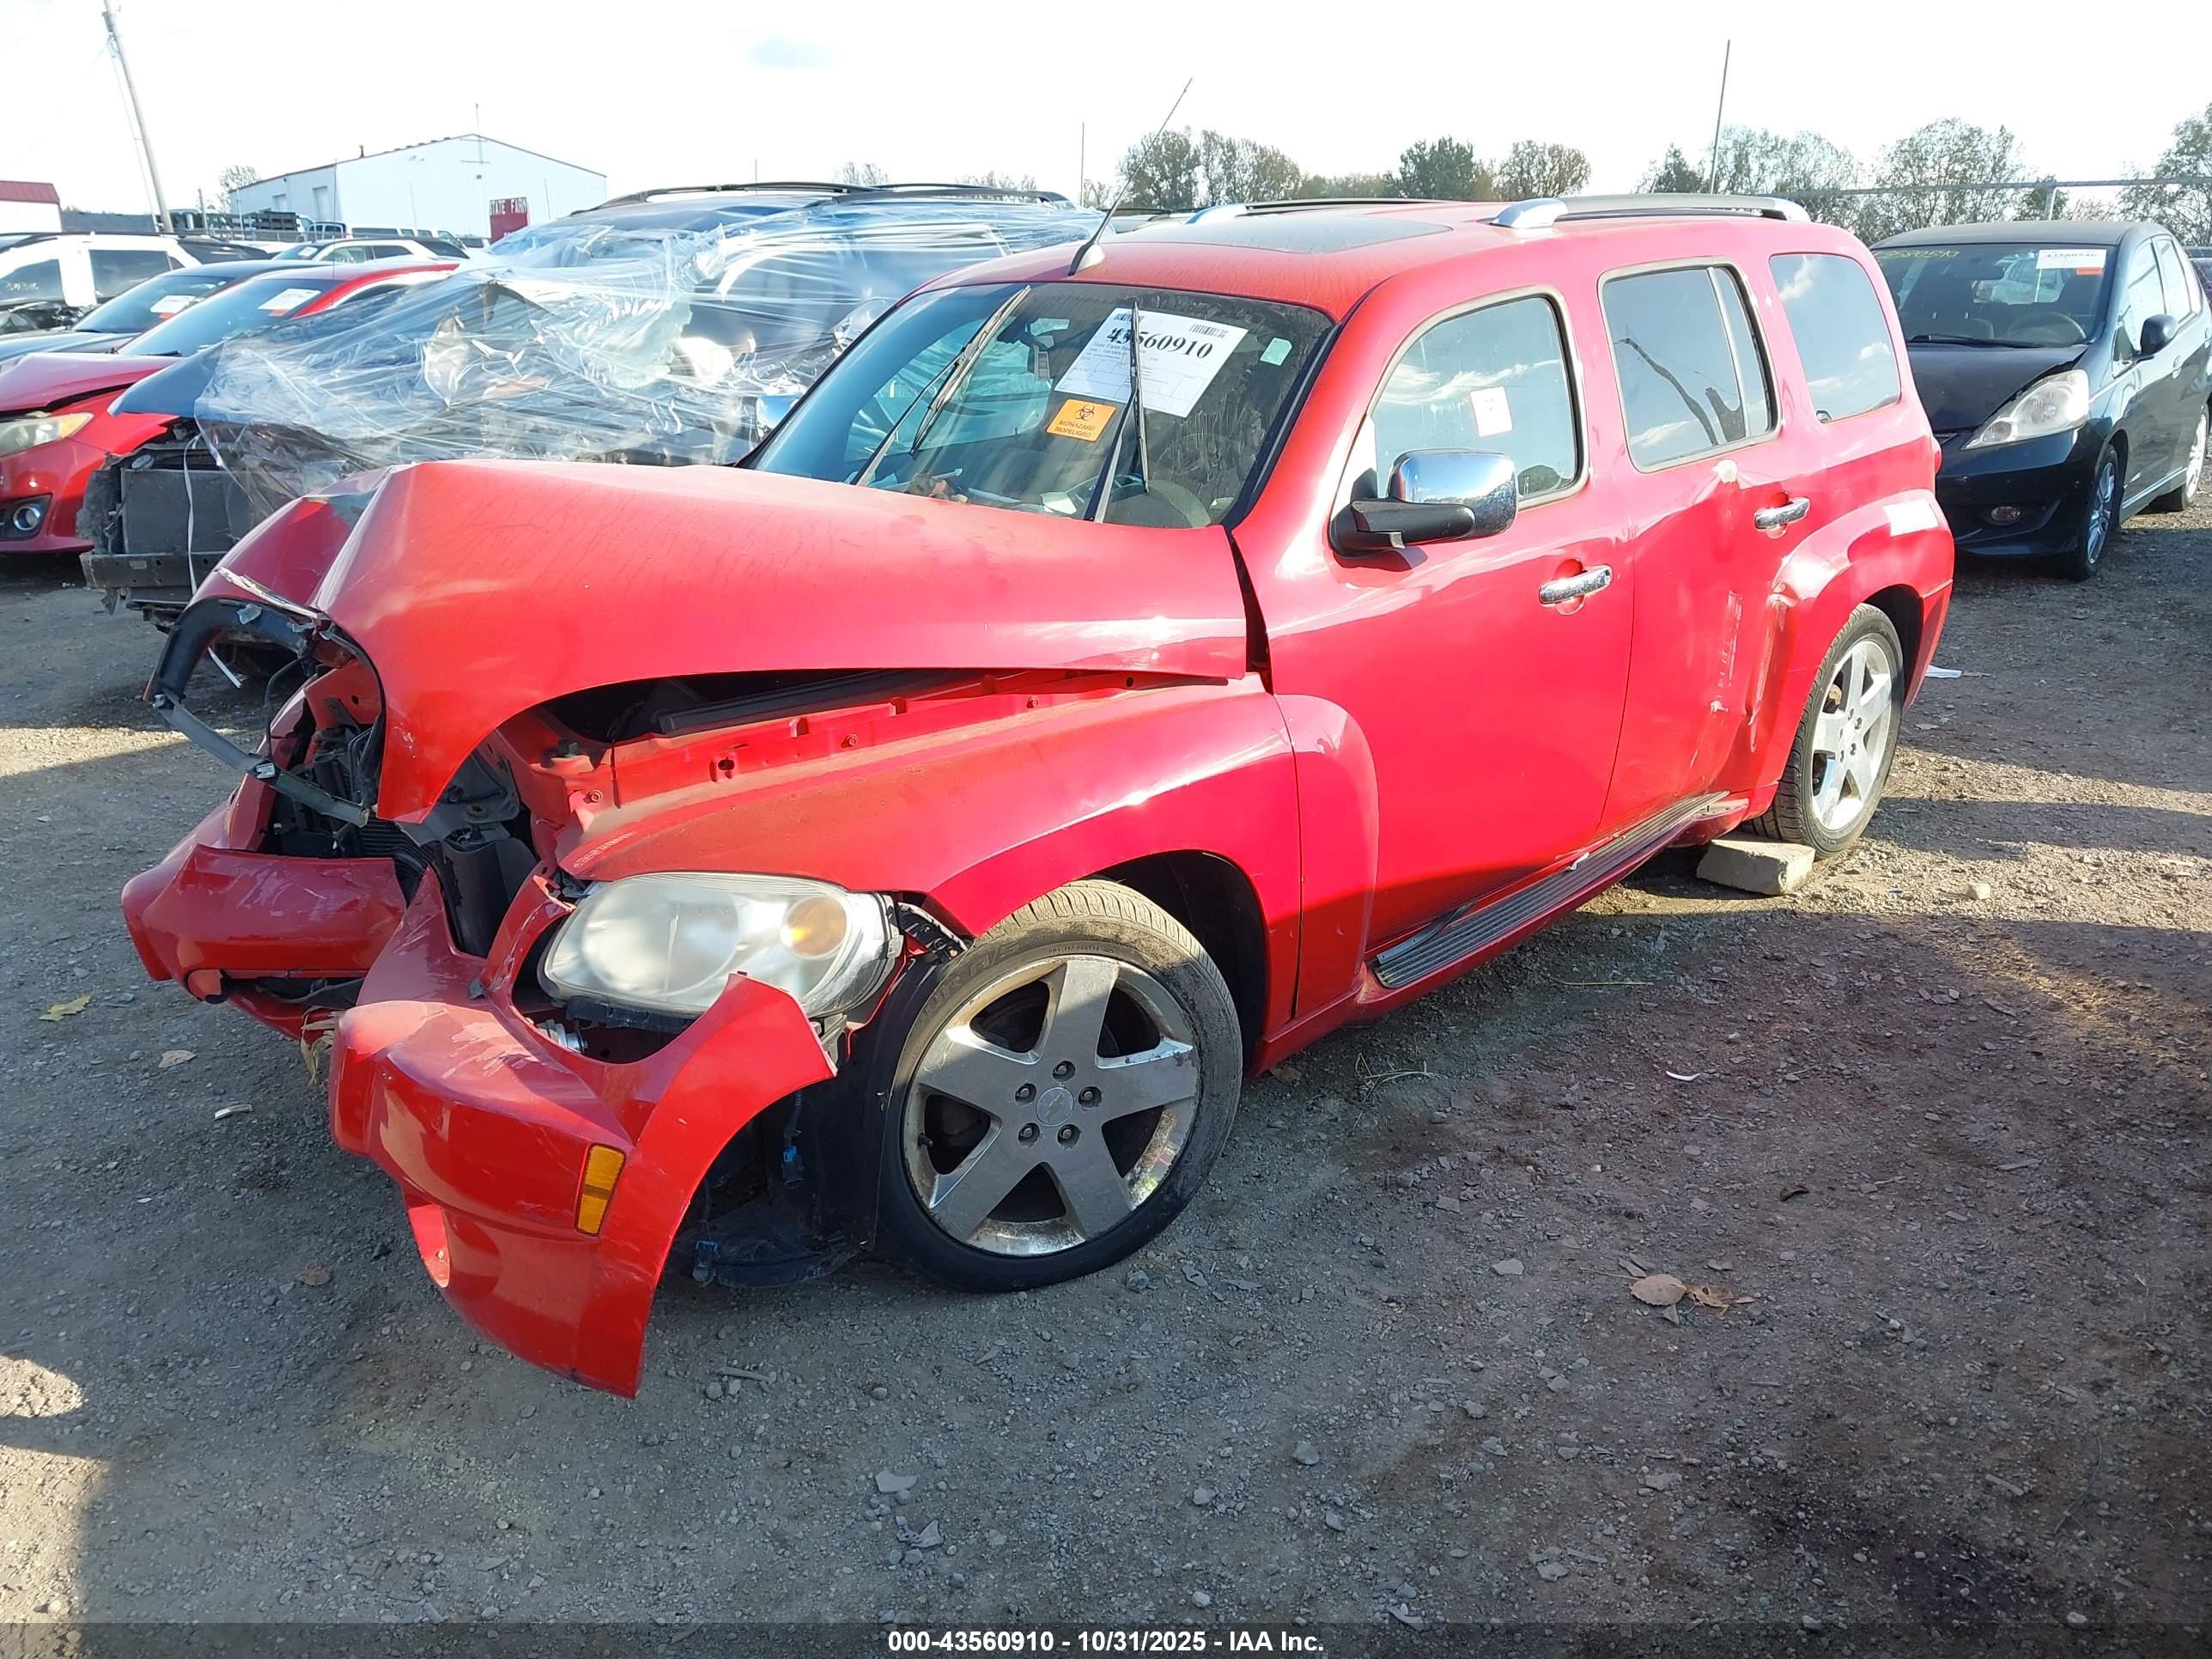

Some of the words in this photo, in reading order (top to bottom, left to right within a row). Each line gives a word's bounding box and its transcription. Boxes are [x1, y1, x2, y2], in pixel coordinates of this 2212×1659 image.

[489, 199, 507, 216] STATE
[1059, 420, 1096, 431] BIOHAZARD
[1054, 426, 1091, 438] BIOPELIGRO
